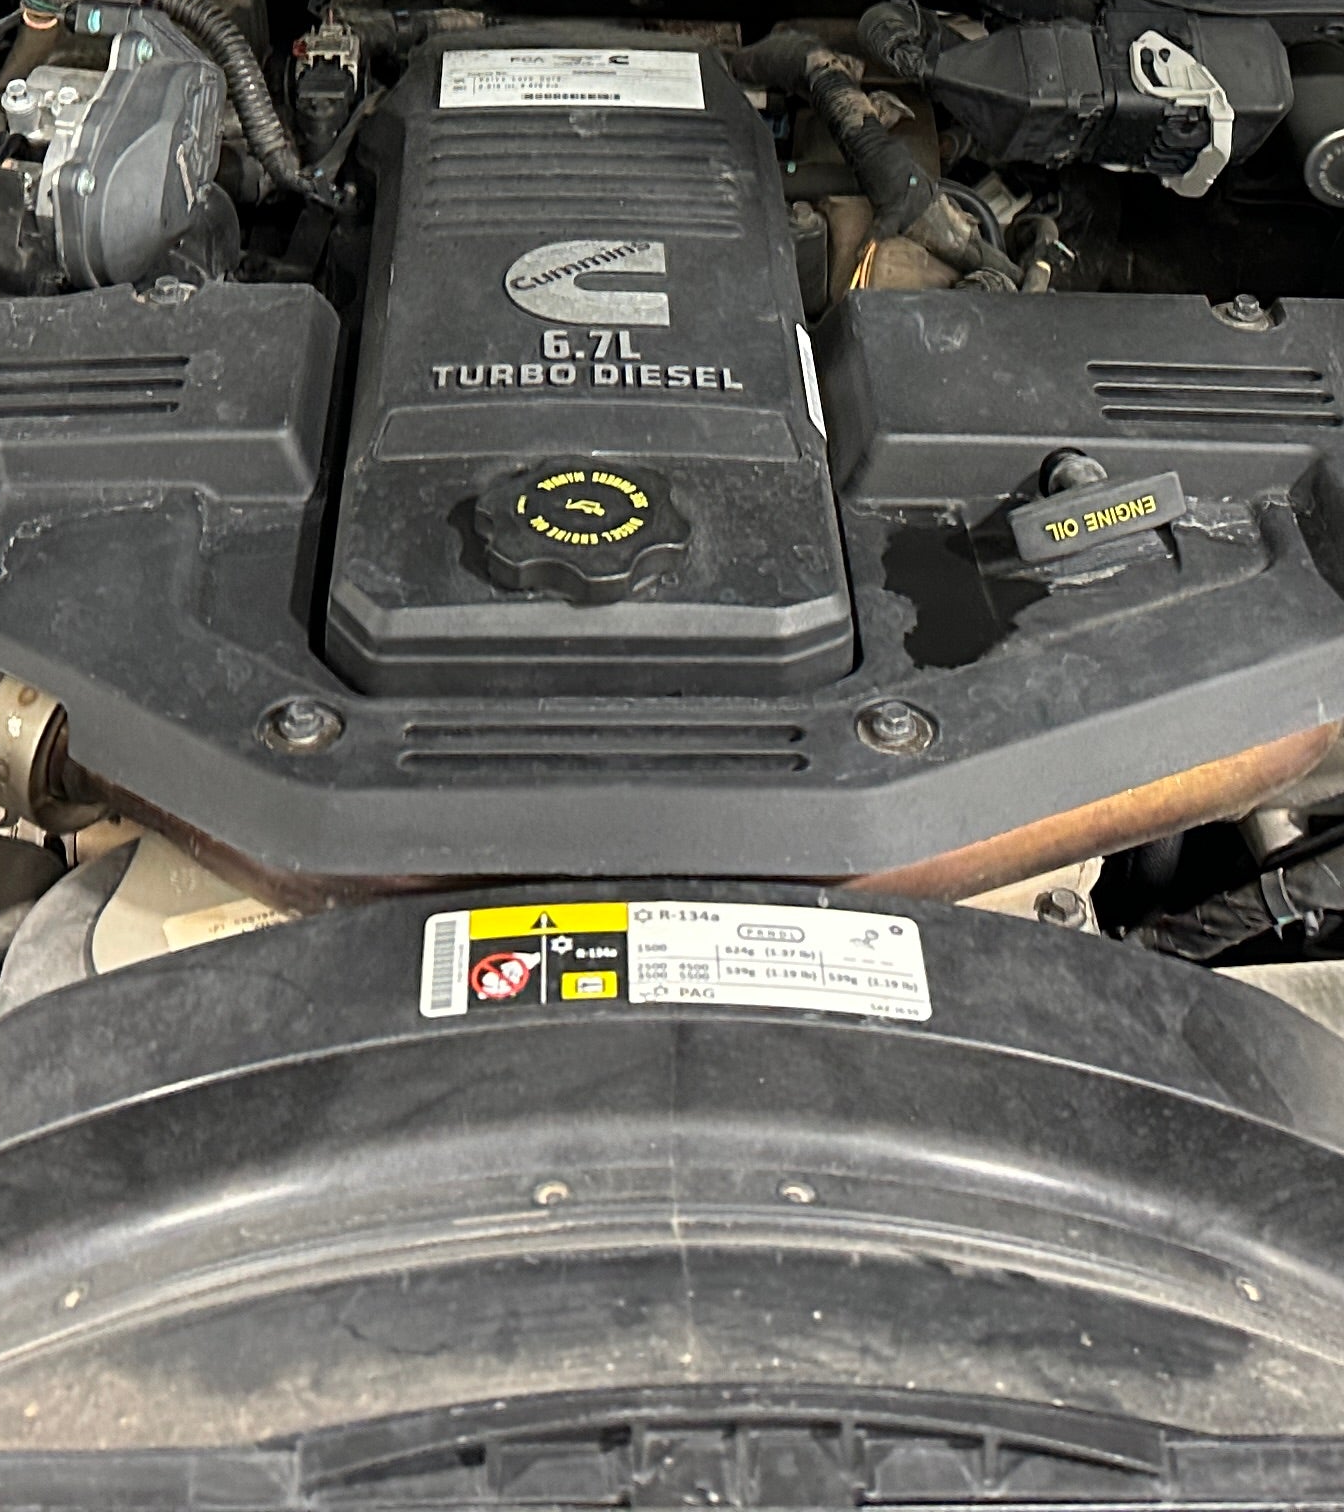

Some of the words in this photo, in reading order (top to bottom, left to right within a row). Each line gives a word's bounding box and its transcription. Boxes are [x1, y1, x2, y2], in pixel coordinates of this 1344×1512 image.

[509, 241, 651, 291] Cummins
[542, 329, 642, 361] 6.7L
[432, 364, 577, 389] TURBO
[593, 365, 744, 391] DIESEL
[1083, 495, 1157, 532] ENGINE
[1045, 518, 1079, 541] OIL
[659, 910, 720, 922] R-134a
[679, 988, 715, 998] PAG
